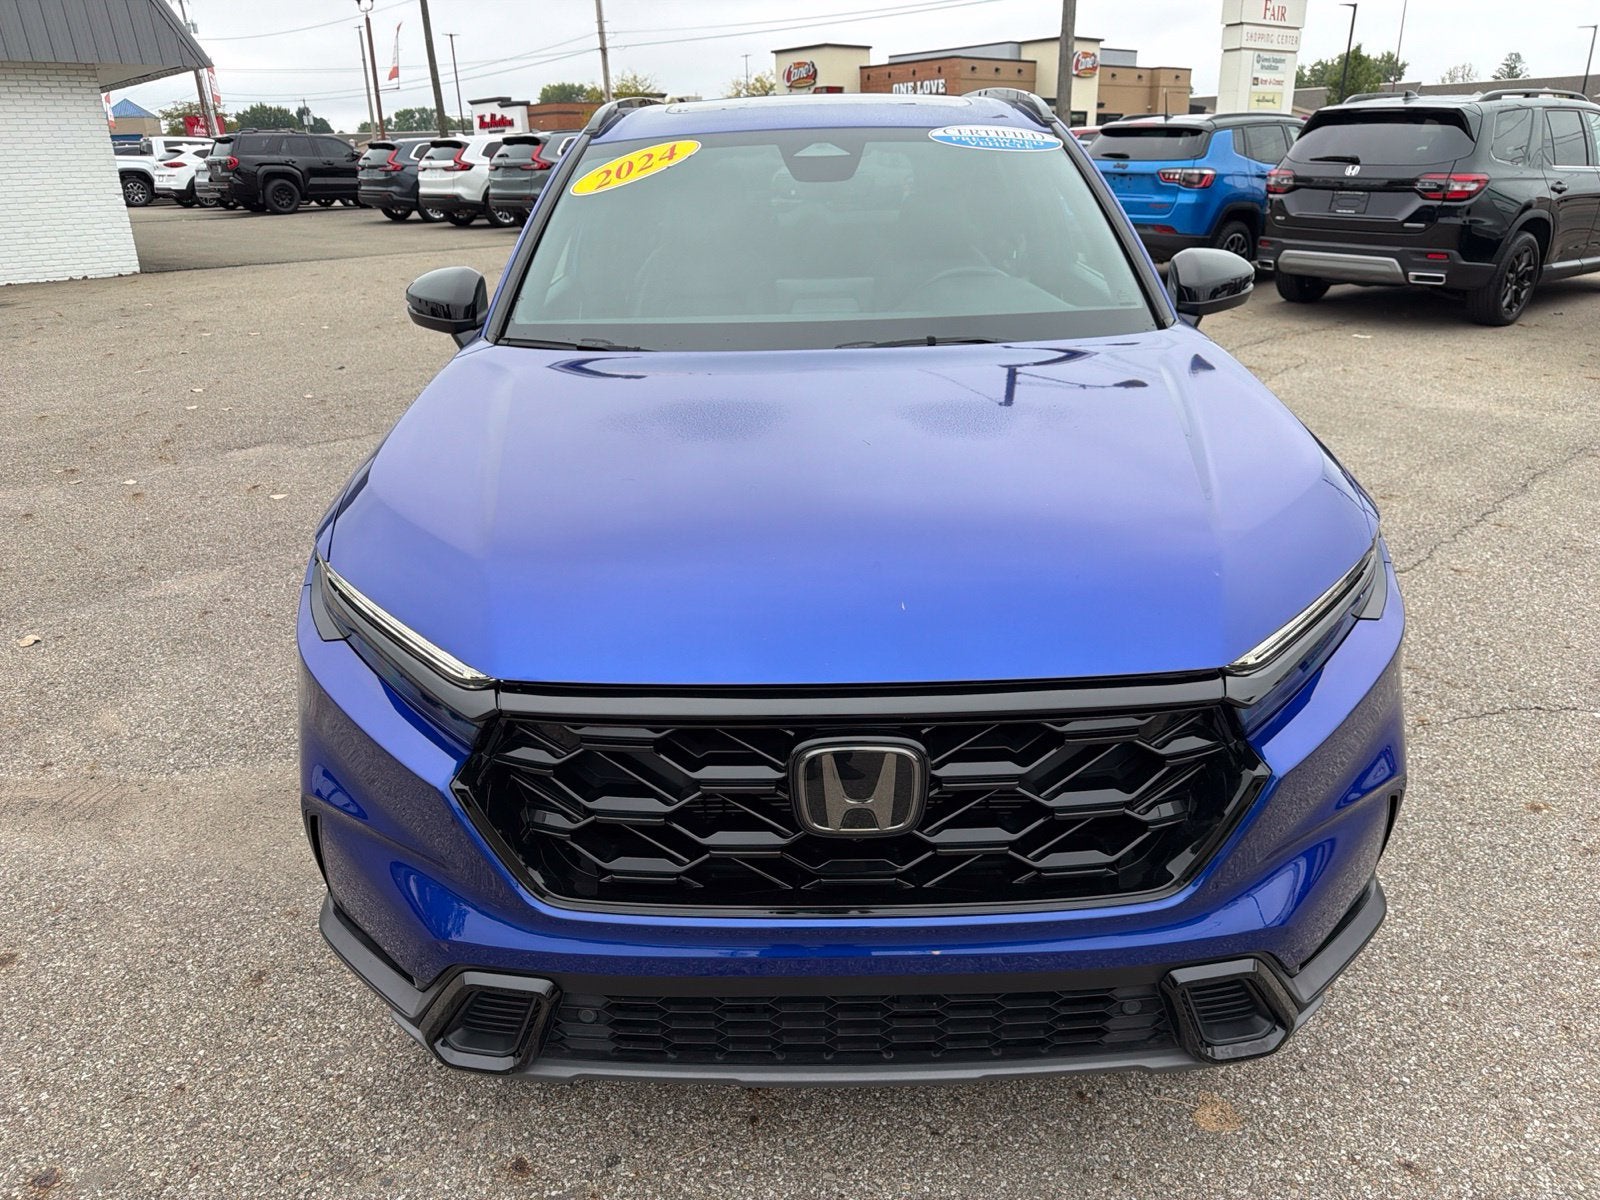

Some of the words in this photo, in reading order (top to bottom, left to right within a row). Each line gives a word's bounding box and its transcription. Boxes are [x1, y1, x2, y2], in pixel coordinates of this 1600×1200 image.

[1262, 0, 1287, 22] FAIR
[1245, 31, 1274, 44] SHOPPING
[1276, 34, 1299, 46] CENTER
[892, 82, 915, 94] ONE
[917, 78, 946, 94] LOVE
[943, 128, 1046, 141] CERTIFIED
[968, 139, 1035, 150] VEHICLE
[594, 143, 678, 191] 2024
